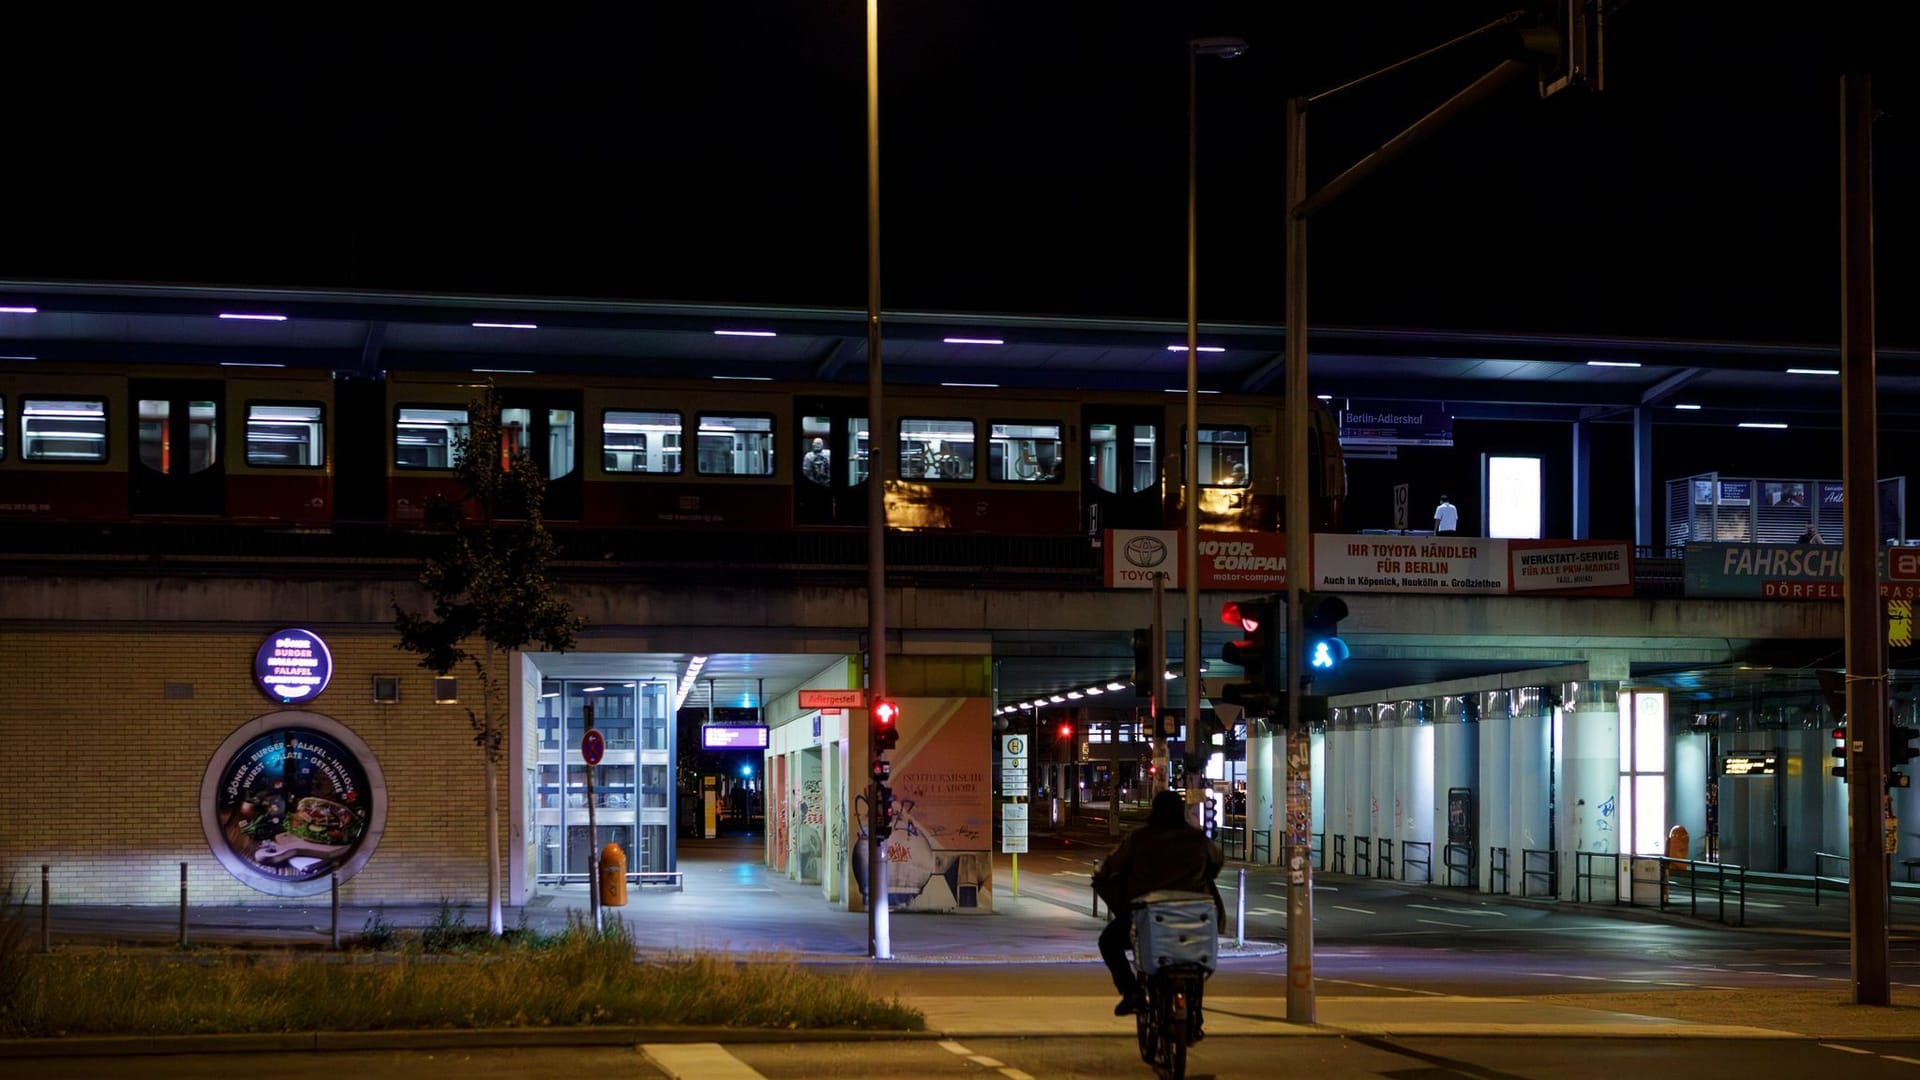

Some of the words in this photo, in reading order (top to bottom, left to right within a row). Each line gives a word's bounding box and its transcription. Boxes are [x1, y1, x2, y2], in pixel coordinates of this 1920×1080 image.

[1346, 413, 1424, 424] Berlin-Adlershof
[1395, 487, 1407, 505] 10
[1398, 507, 1404, 526] 2
[1348, 544, 1368, 557] IHR
[1373, 544, 1417, 557] TOYOTA
[1421, 543, 1478, 558] HÄNDLER
[1521, 550, 1620, 565] WERKSTATT-SERVICE
[1377, 559, 1400, 574] FÜR
[1405, 561, 1449, 574] BERLIN
[1723, 548, 1884, 577] FAHRSCH
[1120, 570, 1170, 581] TOYOA
[1521, 565, 1539, 576] FÜR
[1540, 565, 1561, 575] ALLE
[1323, 576, 1345, 586] Auch
[1347, 577, 1356, 586] in
[1358, 576, 1400, 587] Köpenick,
[1402, 577, 1439, 587] Neukölln
[1441, 579, 1449, 587] u.
[1451, 578, 1501, 588] Großziethen
[274, 649, 312, 657] BURGER
[273, 667, 312, 675] FALAFEL
[250, 742, 285, 761] BURGER
[292, 741, 327, 758] FALAFEL
[242, 762, 265, 788] WURST
[310, 757, 343, 793] GETRÄNKE
